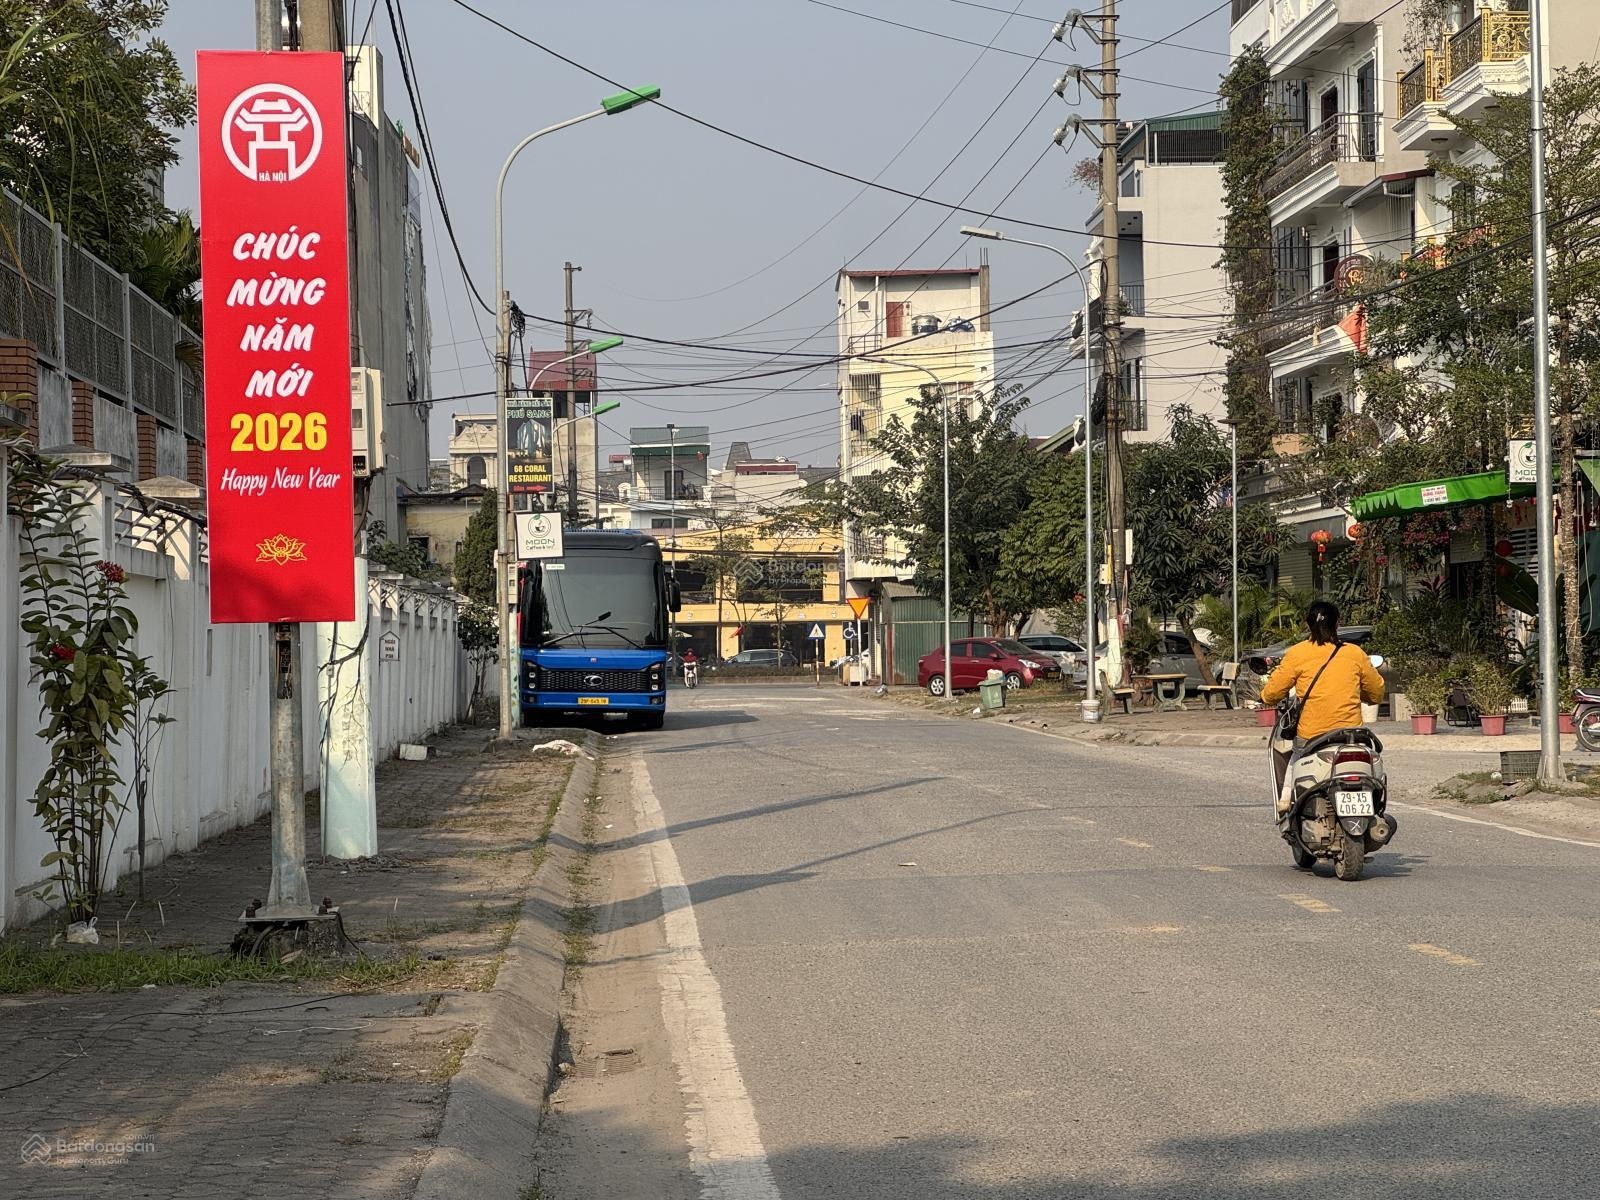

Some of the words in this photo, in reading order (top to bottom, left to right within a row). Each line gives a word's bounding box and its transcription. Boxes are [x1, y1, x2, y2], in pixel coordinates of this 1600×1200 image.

[259, 171, 270, 181] HÀ
[272, 171, 287, 183] NỘI
[232, 225, 321, 261] CHÚC
[226, 271, 327, 307] MỪNG
[239, 316, 315, 352] NĂM
[244, 362, 314, 398] MỚI
[526, 409, 552, 419] SANG
[230, 412, 327, 451] 2026
[514, 464, 523, 473] 68
[524, 464, 546, 473] CORAL
[220, 467, 268, 497] Happy
[271, 466, 304, 489] New
[308, 466, 341, 489] Year
[508, 474, 552, 483] RESTAURANT
[525, 538, 555, 546] MOON
[1341, 792, 1367, 803] 29-X5
[1339, 803, 1372, 815] 406.22
